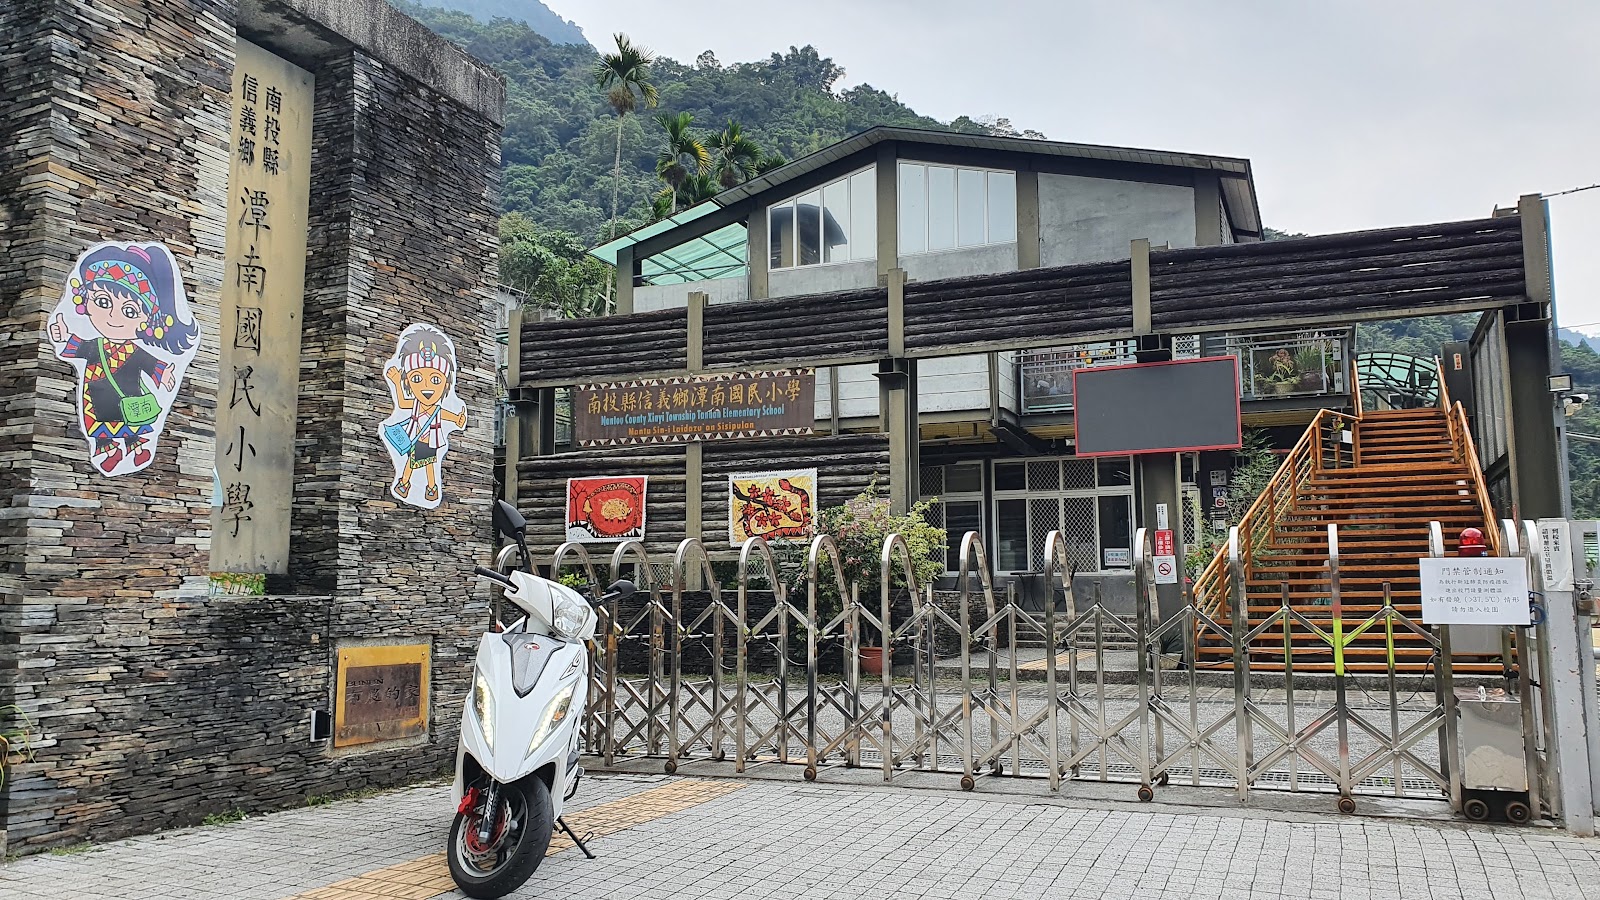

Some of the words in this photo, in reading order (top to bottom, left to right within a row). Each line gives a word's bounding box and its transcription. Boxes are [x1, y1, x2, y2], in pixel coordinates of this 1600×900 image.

[238, 73, 258, 166] 信義鄉
[263, 86, 282, 176] 南投縣
[220, 186, 271, 538] 潭南國民小學
[127, 398, 152, 418] 潭南
[588, 379, 801, 414] 南投縣信義鄉潭南國民小學
[600, 415, 624, 427] Nantou
[624, 413, 647, 426] County
[647, 412, 665, 425] Xinyi
[665, 409, 696, 423] Township
[697, 409, 721, 420] Tannan
[723, 406, 761, 419] Elementary
[762, 403, 785, 416] School
[628, 427, 651, 436] Nantu
[653, 426, 670, 435] Sin-i
[717, 421, 755, 432] Sisipulan
[1441, 567, 1504, 576] 門禁管制通知
